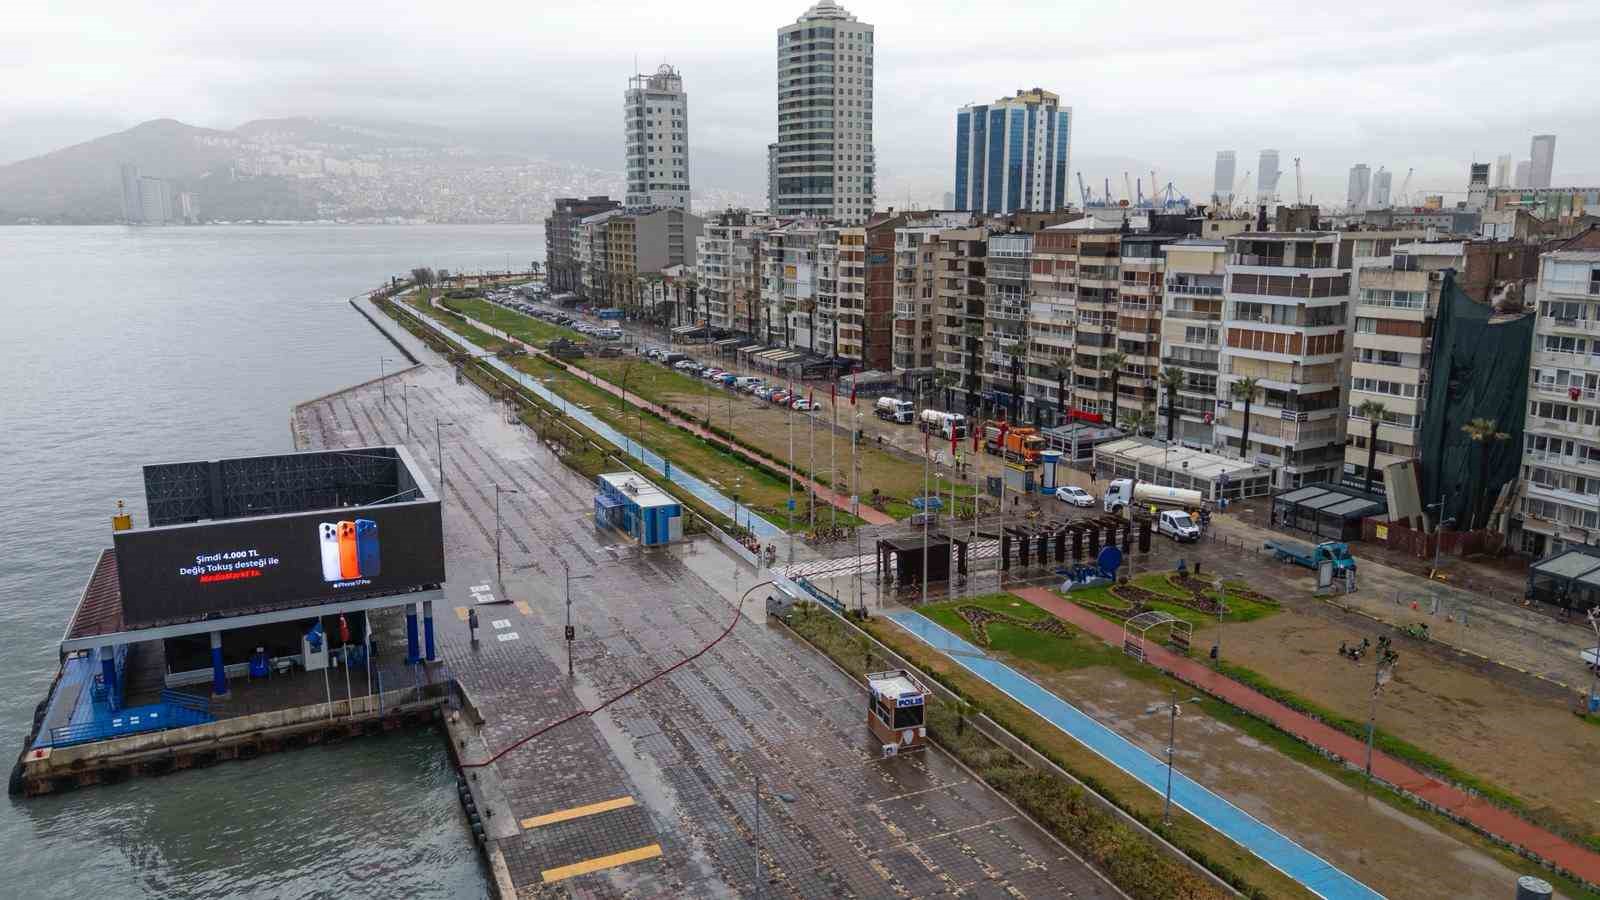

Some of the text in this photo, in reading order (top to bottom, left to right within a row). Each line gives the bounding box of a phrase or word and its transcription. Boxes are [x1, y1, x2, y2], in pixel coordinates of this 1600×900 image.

[196, 549, 259, 564] Şimdi 4.000 TL
[180, 557, 279, 576] Değiş Tokuş desteği ile
